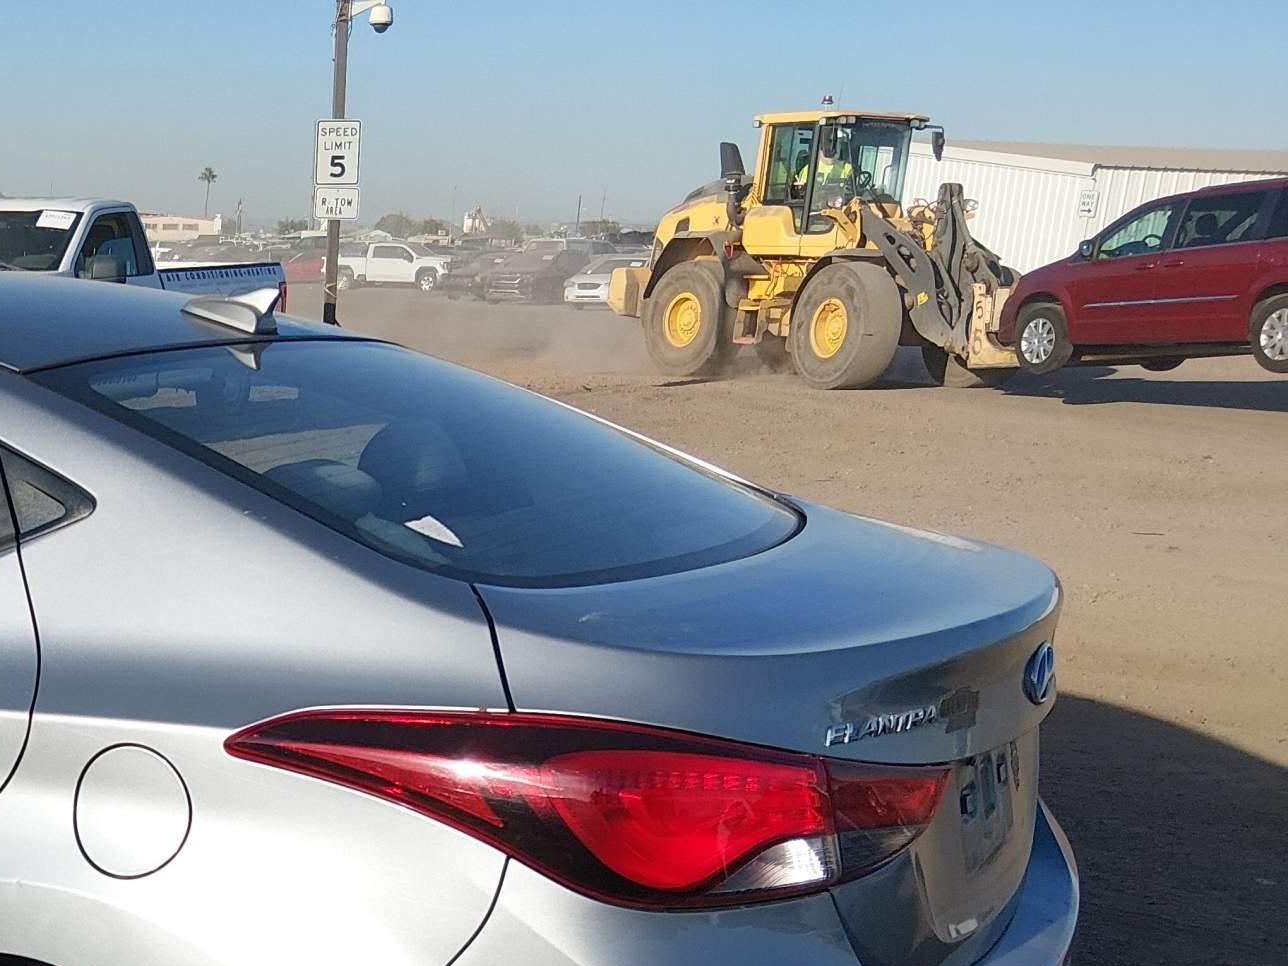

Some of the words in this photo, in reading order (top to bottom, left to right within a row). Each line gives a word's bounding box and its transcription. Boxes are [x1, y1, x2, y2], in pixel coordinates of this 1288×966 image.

[321, 127, 358, 136] SPEED
[324, 141, 353, 150] LIMIT
[329, 155, 346, 178] 5
[166, 273, 181, 282] AIR
[825, 704, 936, 747] ELANTRA
